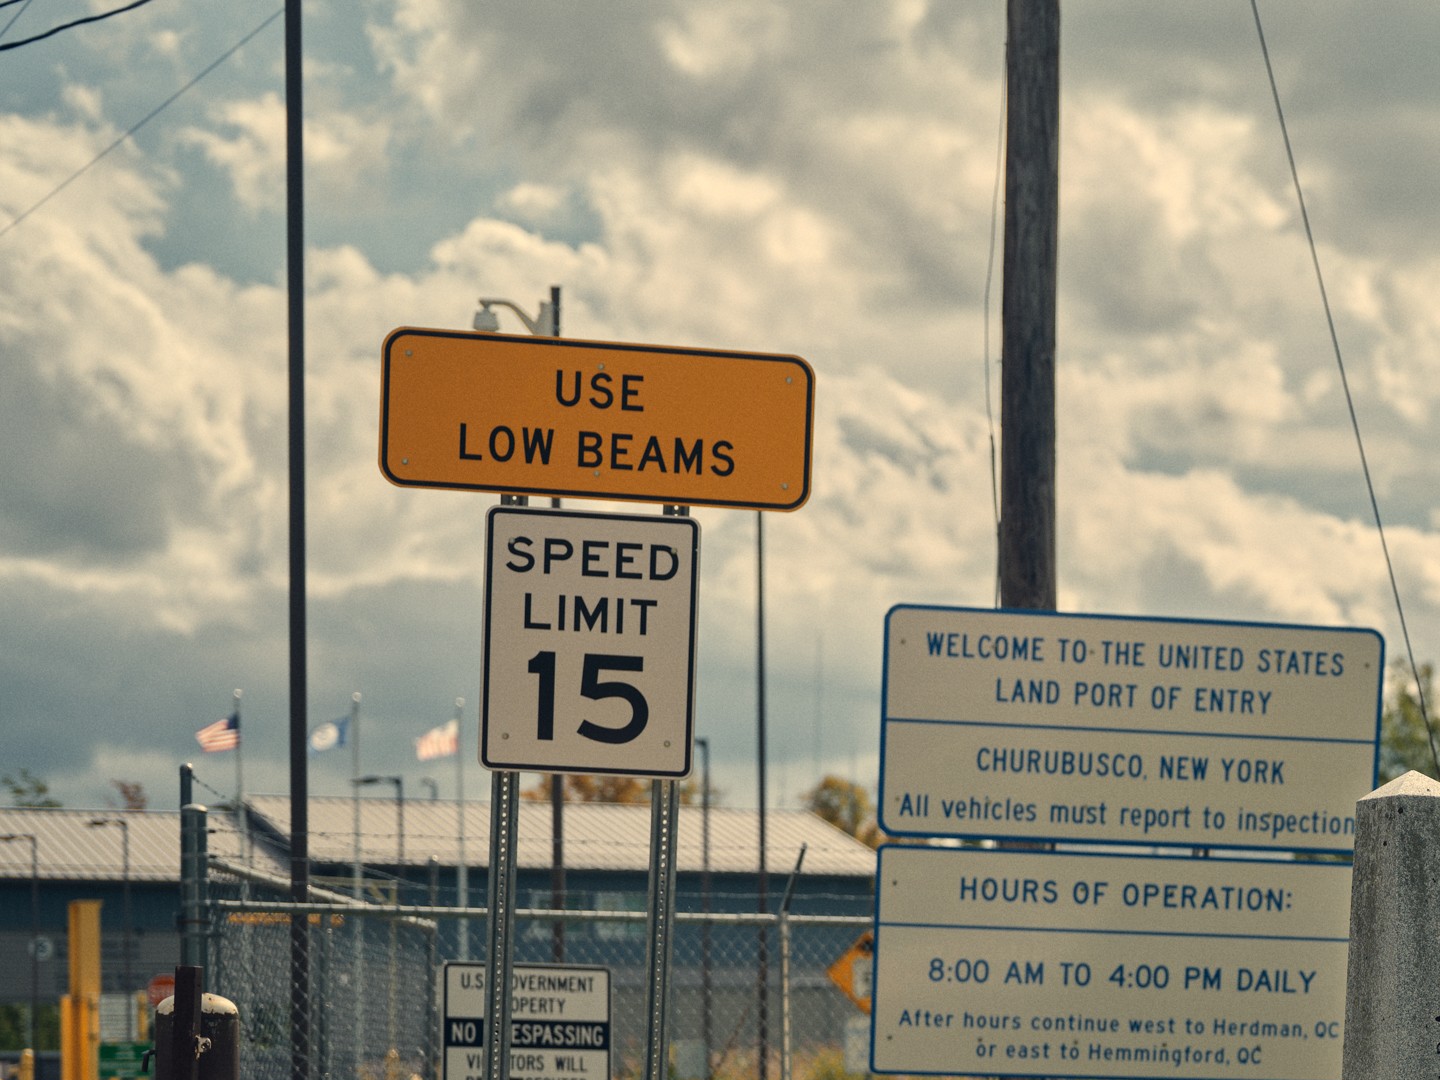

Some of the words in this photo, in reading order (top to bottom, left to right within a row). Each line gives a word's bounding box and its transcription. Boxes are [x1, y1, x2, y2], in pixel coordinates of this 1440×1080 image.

[556, 369, 644, 412] USE
[459, 422, 554, 464] LOW
[578, 431, 735, 476] BEAMS
[505, 536, 679, 581] SPEED
[524, 593, 657, 635] LIMIT
[927, 631, 1045, 662] WELCOME
[1058, 639, 1088, 663] TO
[1102, 641, 1145, 667] THE
[1159, 644, 1244, 672] UNITED
[1258, 649, 1344, 676] STATES
[528, 651, 649, 744] 15
[996, 678, 1059, 705] LAND
[1074, 682, 1137, 708] PORT
[1151, 686, 1182, 710] OF
[1195, 688, 1272, 715] ENTRY
[976, 747, 1148, 780] CHURUBUSCO,
[1160, 755, 1209, 781] NEW
[1222, 758, 1284, 785] YORK
[900, 793, 928, 818] All
[941, 795, 1036, 822] vehicles
[1049, 801, 1106, 825] must
[1119, 803, 1190, 834] report
[1204, 808, 1225, 830] to
[1238, 809, 1355, 838] inspection
[960, 876, 1057, 903] HOURS
[1073, 881, 1108, 905] OF
[1123, 884, 1293, 912] OPERATION:
[462, 973, 484, 988] U.S
[513, 975, 594, 992] OVERNMENT
[928, 958, 989, 984] 8:00
[1004, 962, 1044, 986] AM
[1060, 962, 1091, 986] TO
[1109, 964, 1169, 989] 4:00
[1184, 967, 1222, 992] PM
[1237, 969, 1317, 994] DAILY
[512, 998, 565, 1013] OPERTY
[900, 1009, 953, 1028] After
[963, 1011, 1021, 1030] hours
[1031, 1014, 1119, 1033] continue
[1129, 1019, 1175, 1034] west
[1184, 1019, 1205, 1035] to
[1213, 1019, 1307, 1039] Herdman,
[1315, 1022, 1339, 1039] QC
[452, 1022, 476, 1042] NO
[512, 1025, 603, 1046] ESPASSING
[467, 1054, 544, 1070] VITORS
[555, 1057, 587, 1072] WILL
[976, 1042, 997, 1058] or
[1006, 1044, 1051, 1060] east
[1060, 1043, 1079, 1060] to
[1088, 1044, 1230, 1067] Hemmingford,
[1237, 1046, 1262, 1065] QC
